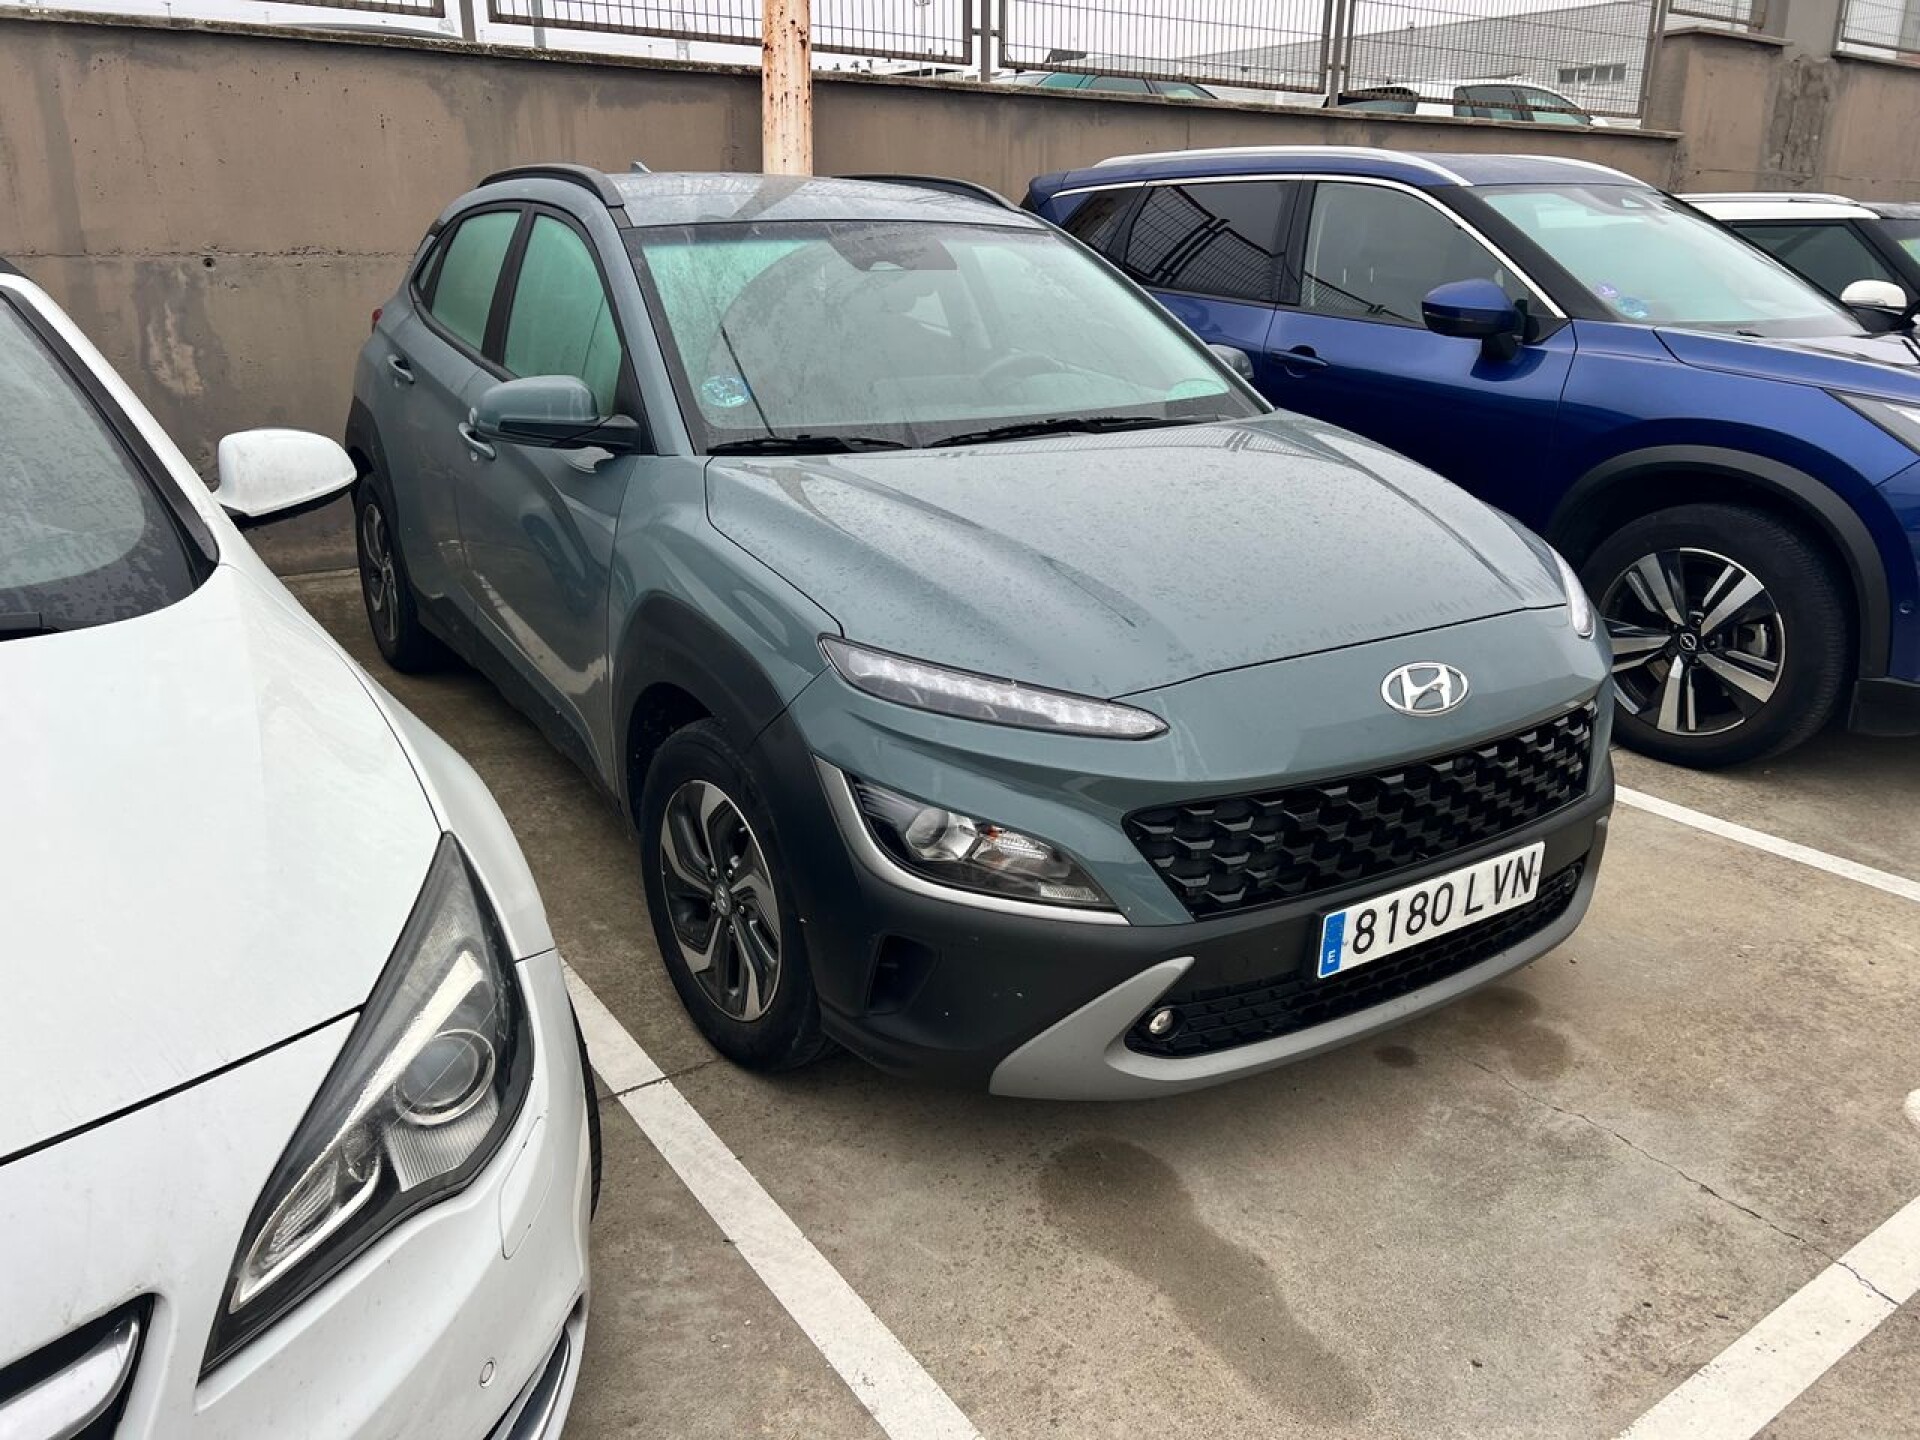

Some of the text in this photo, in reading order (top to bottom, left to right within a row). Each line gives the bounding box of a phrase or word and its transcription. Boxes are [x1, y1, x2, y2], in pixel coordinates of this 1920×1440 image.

[1353, 851, 1537, 954] 8180 LVN
[1327, 949, 1336, 964] E
